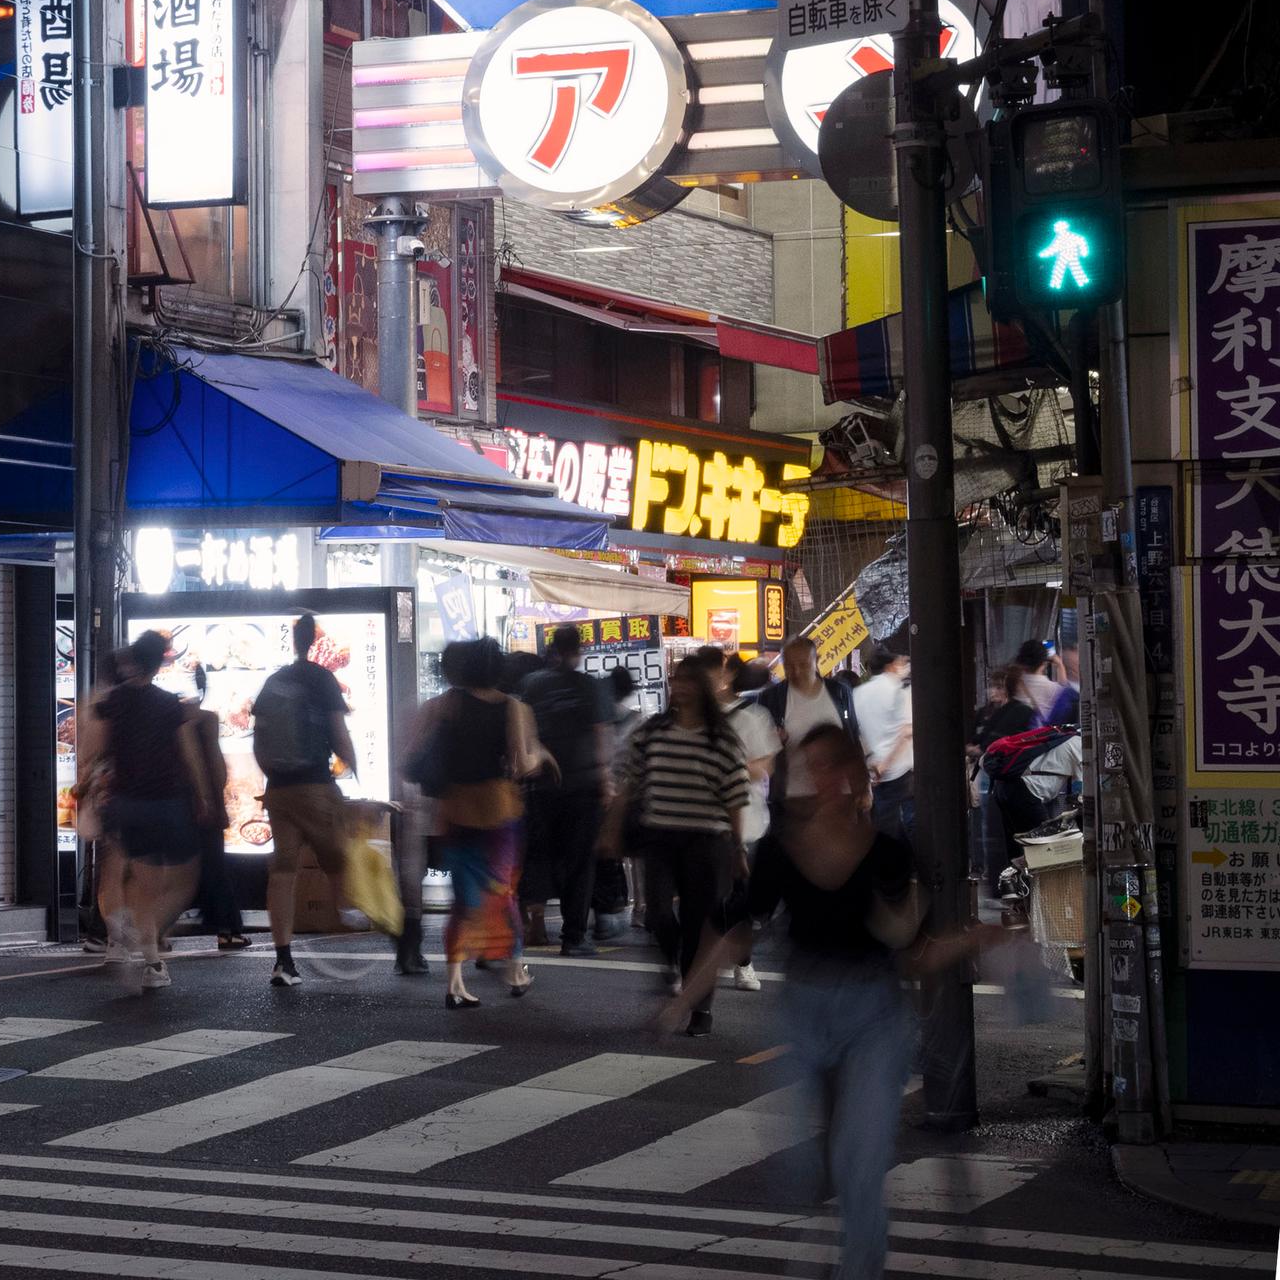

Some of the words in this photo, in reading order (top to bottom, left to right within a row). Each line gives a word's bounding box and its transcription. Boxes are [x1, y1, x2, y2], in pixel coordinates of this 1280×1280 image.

[511, 41, 639, 179] ア
[1202, 820, 1280, 844] 切通橋ガ
[1201, 871, 1266, 887] 自動車等が
[1201, 888, 1280, 903] のを見た方は
[1201, 926, 1254, 939] JR東日本
